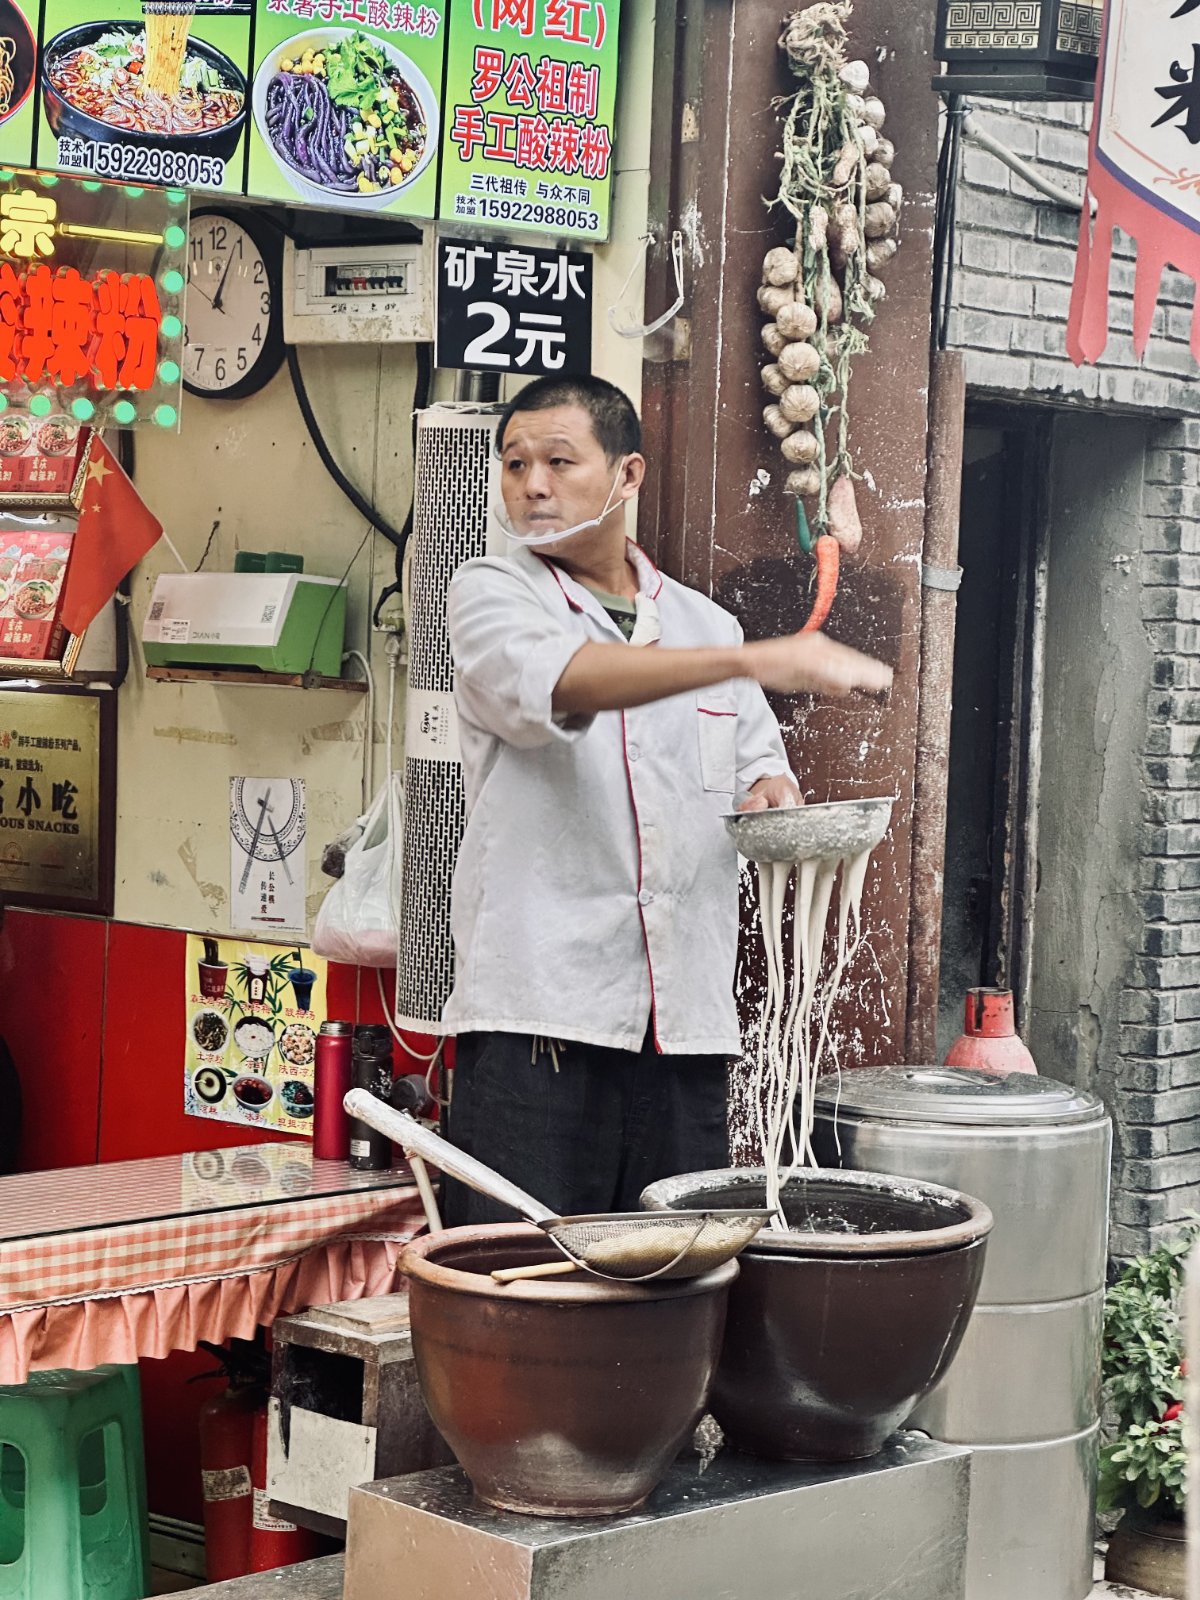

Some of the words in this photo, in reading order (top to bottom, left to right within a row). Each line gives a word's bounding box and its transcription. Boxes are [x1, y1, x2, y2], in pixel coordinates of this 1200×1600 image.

[472, 49, 600, 117] 罗公祖制
[59, 139, 83, 152] 技术
[453, 107, 612, 177] 手工酸辣粉
[58, 154, 82, 167] 加盟
[85, 144, 223, 186] 15922988053
[456, 195, 477, 206] 技术
[471, 174, 527, 196] 三代祖传
[536, 182, 590, 205] 与众不同
[455, 205, 476, 215] 加盟
[480, 198, 599, 231] 15922988053
[208, 226, 227, 250] 12
[236, 239, 243, 259] 1
[190, 240, 203, 260] 11
[253, 260, 264, 284] 2
[444, 246, 586, 301] 矿泉水
[260, 292, 270, 315] 3
[251, 323, 262, 345] 4
[463, 301, 567, 369] 2元
[194, 348, 205, 370] 7
[215, 358, 226, 380] 6
[237, 347, 247, 370] 5
[0, 776, 79, 820] 小吃
[28, 820, 79, 834] SNACKS
[279, 1064, 314, 1077] 陕西凉
